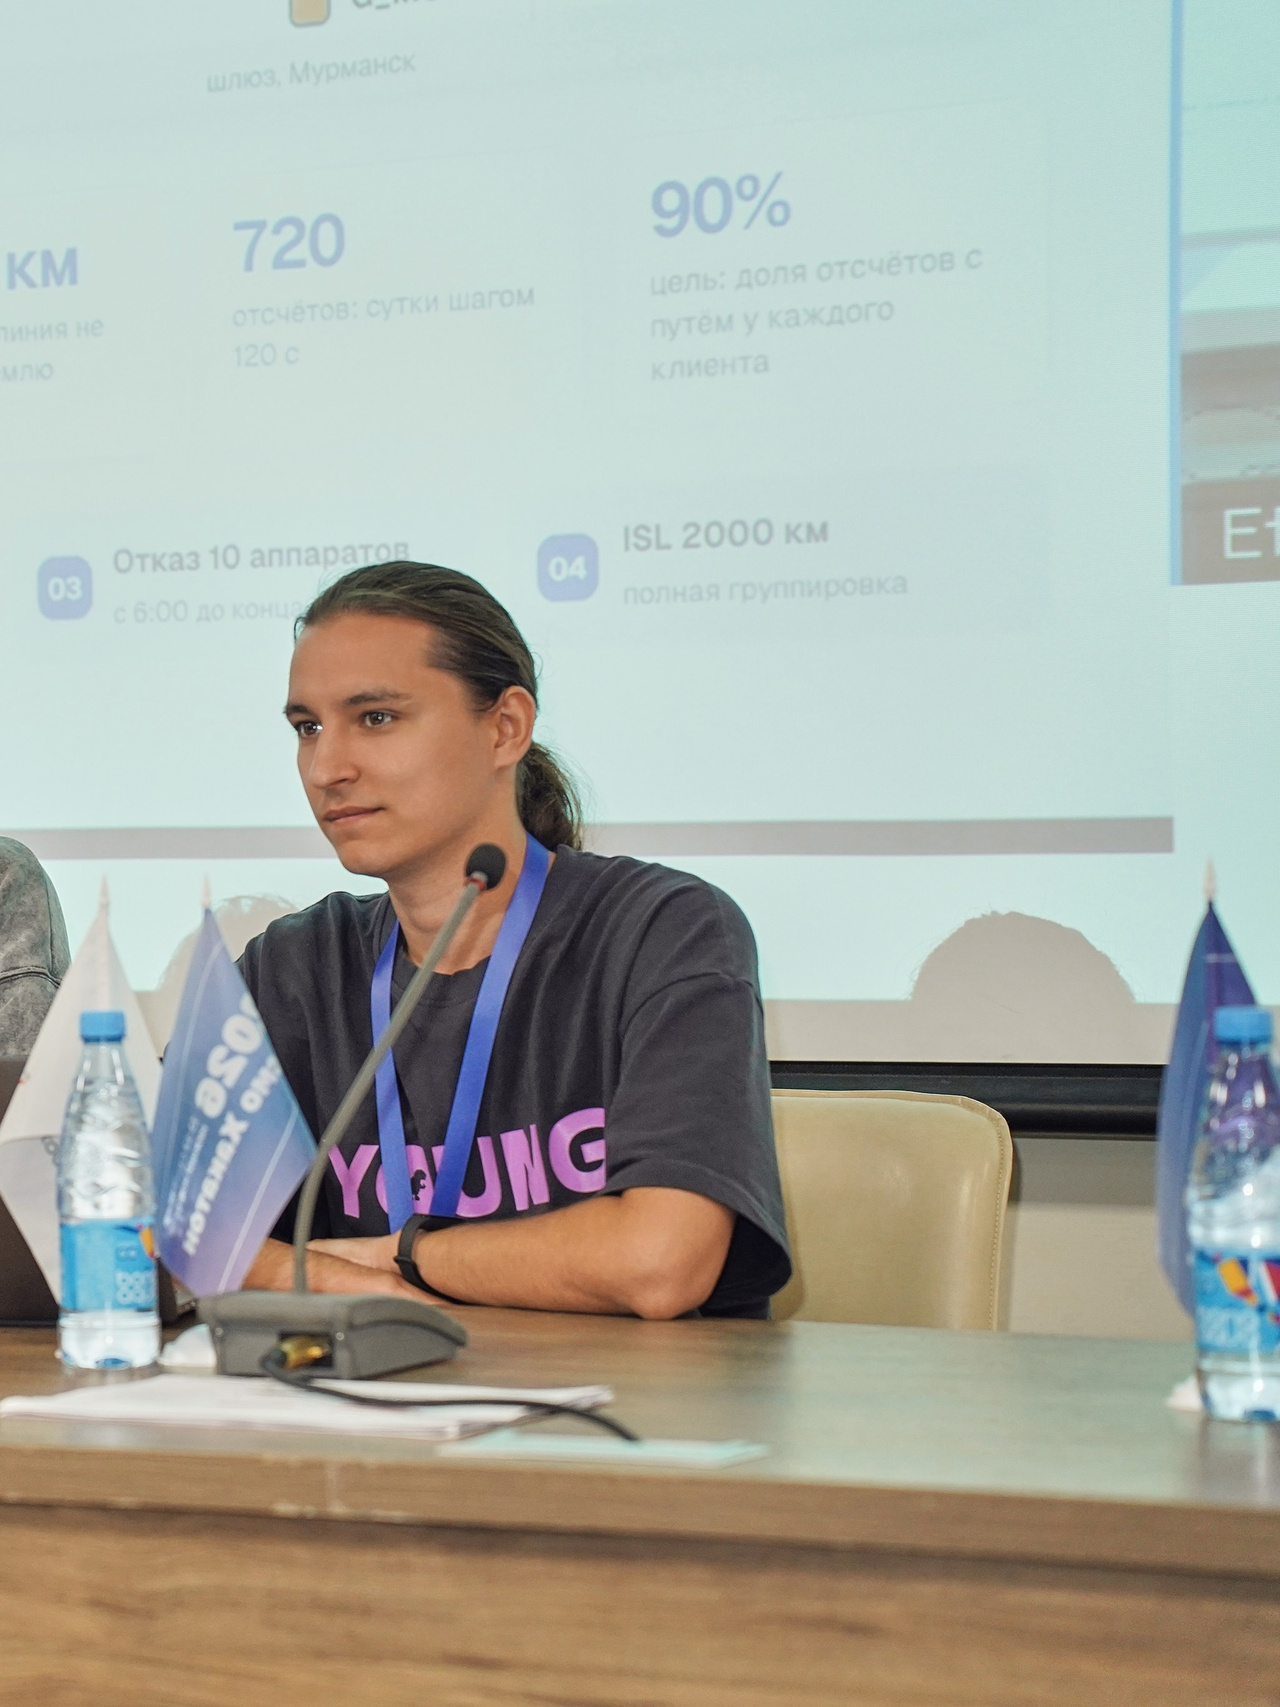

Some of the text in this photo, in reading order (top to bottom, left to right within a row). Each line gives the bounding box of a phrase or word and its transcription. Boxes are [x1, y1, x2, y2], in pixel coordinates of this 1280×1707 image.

[206, 53, 418, 94] шлюз, Мурманск
[651, 171, 793, 239] 90%
[232, 212, 346, 273] 720
[6, 246, 79, 291] км
[650, 248, 984, 296] цель: доля отсчётов с
[232, 287, 536, 328] отсчётов: сутки шагом
[650, 300, 895, 342] путём у каждого
[76, 318, 104, 339] не
[234, 343, 300, 368] 120 с
[650, 354, 770, 381] клиента
[623, 517, 830, 553] ISL 2000 км
[112, 541, 411, 575] Отказ 10 аппаратов
[548, 556, 587, 581] 04
[47, 576, 82, 600] 03
[623, 575, 908, 606] полная группировка
[113, 605, 126, 625] с
[132, 600, 188, 624] 6:00
[196, 602, 224, 623] до
[327, 1107, 607, 1218] YOUNG
